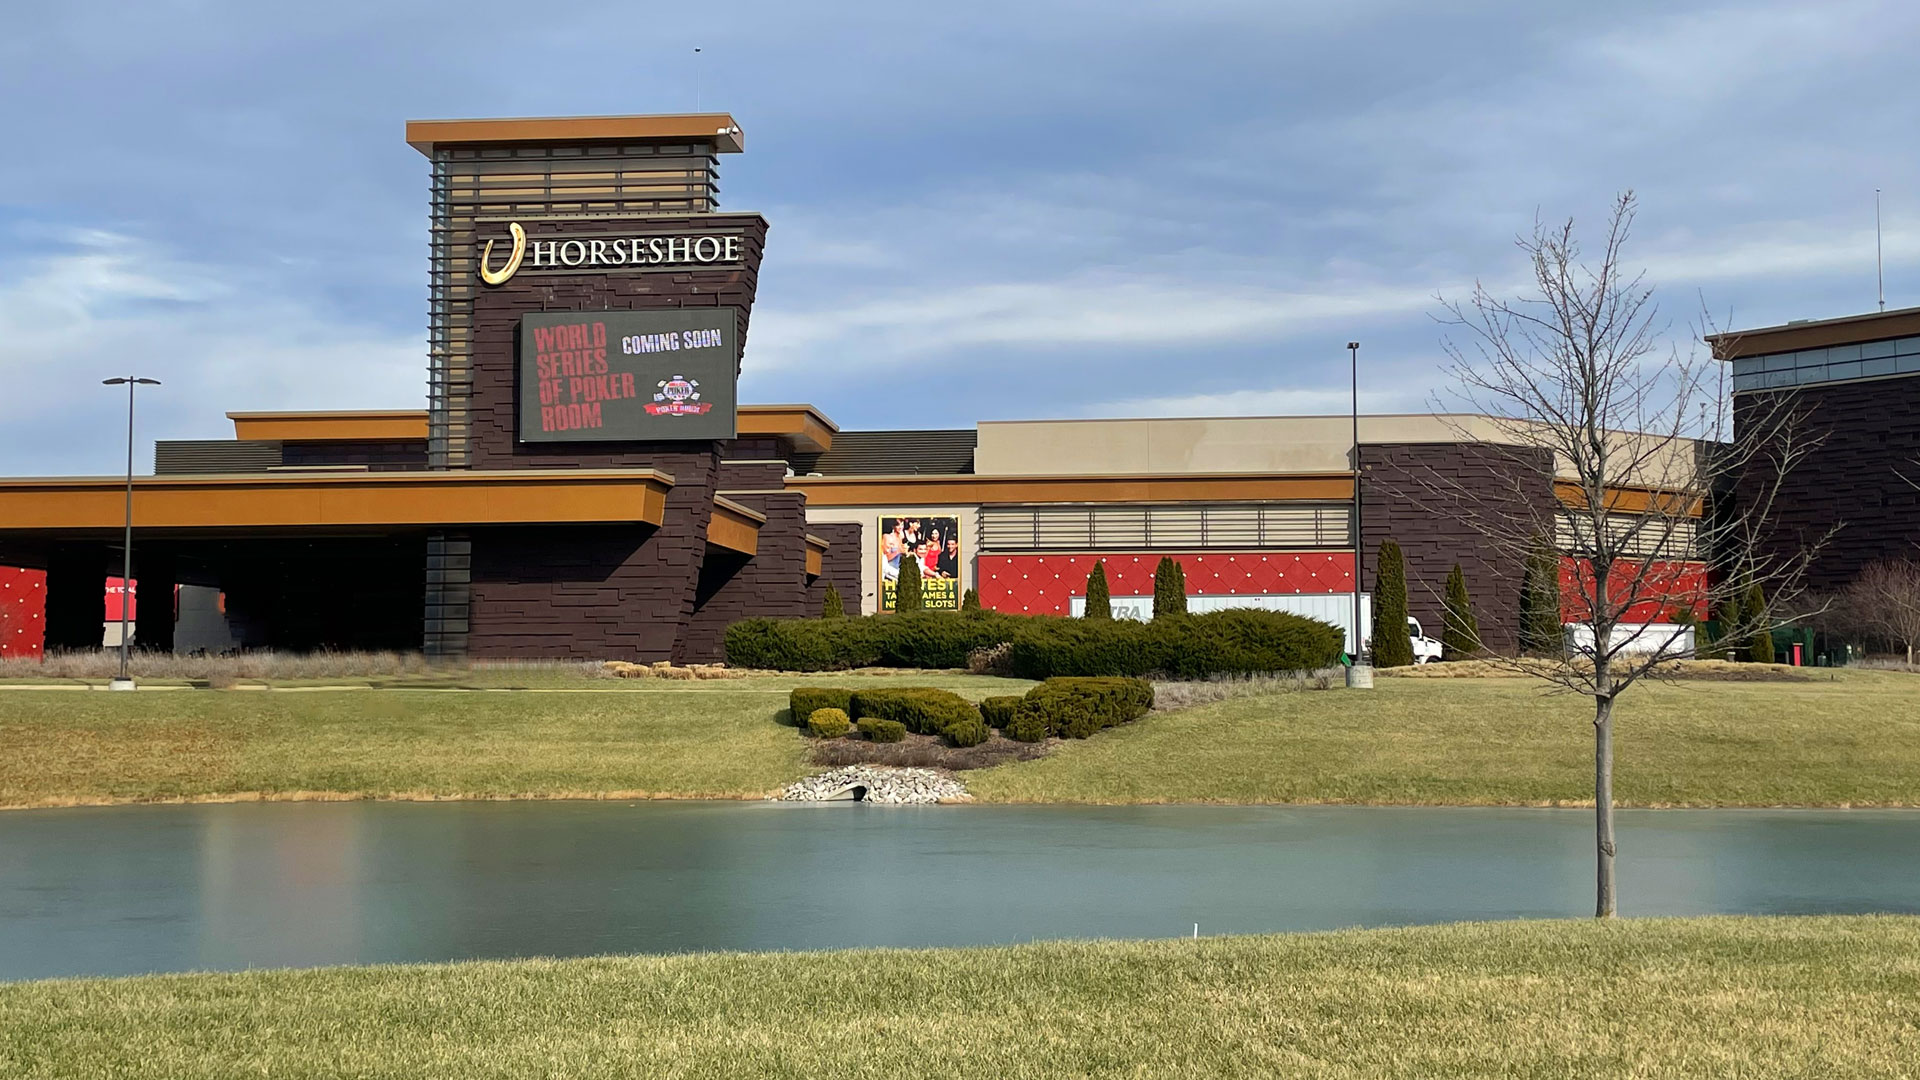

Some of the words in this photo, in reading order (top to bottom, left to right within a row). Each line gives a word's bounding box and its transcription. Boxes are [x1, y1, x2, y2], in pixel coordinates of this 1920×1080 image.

[532, 236, 739, 266] HORSESHOE
[534, 322, 607, 352] WORLD
[621, 331, 680, 355] COMING
[683, 328, 722, 350] SOON
[537, 349, 608, 379] SERIES
[539, 378, 563, 405] OF
[569, 372, 636, 402] POKER
[541, 402, 603, 432] ROOM
[884, 578, 956, 590] HTEST
[1110, 606, 1141, 619] TRA
